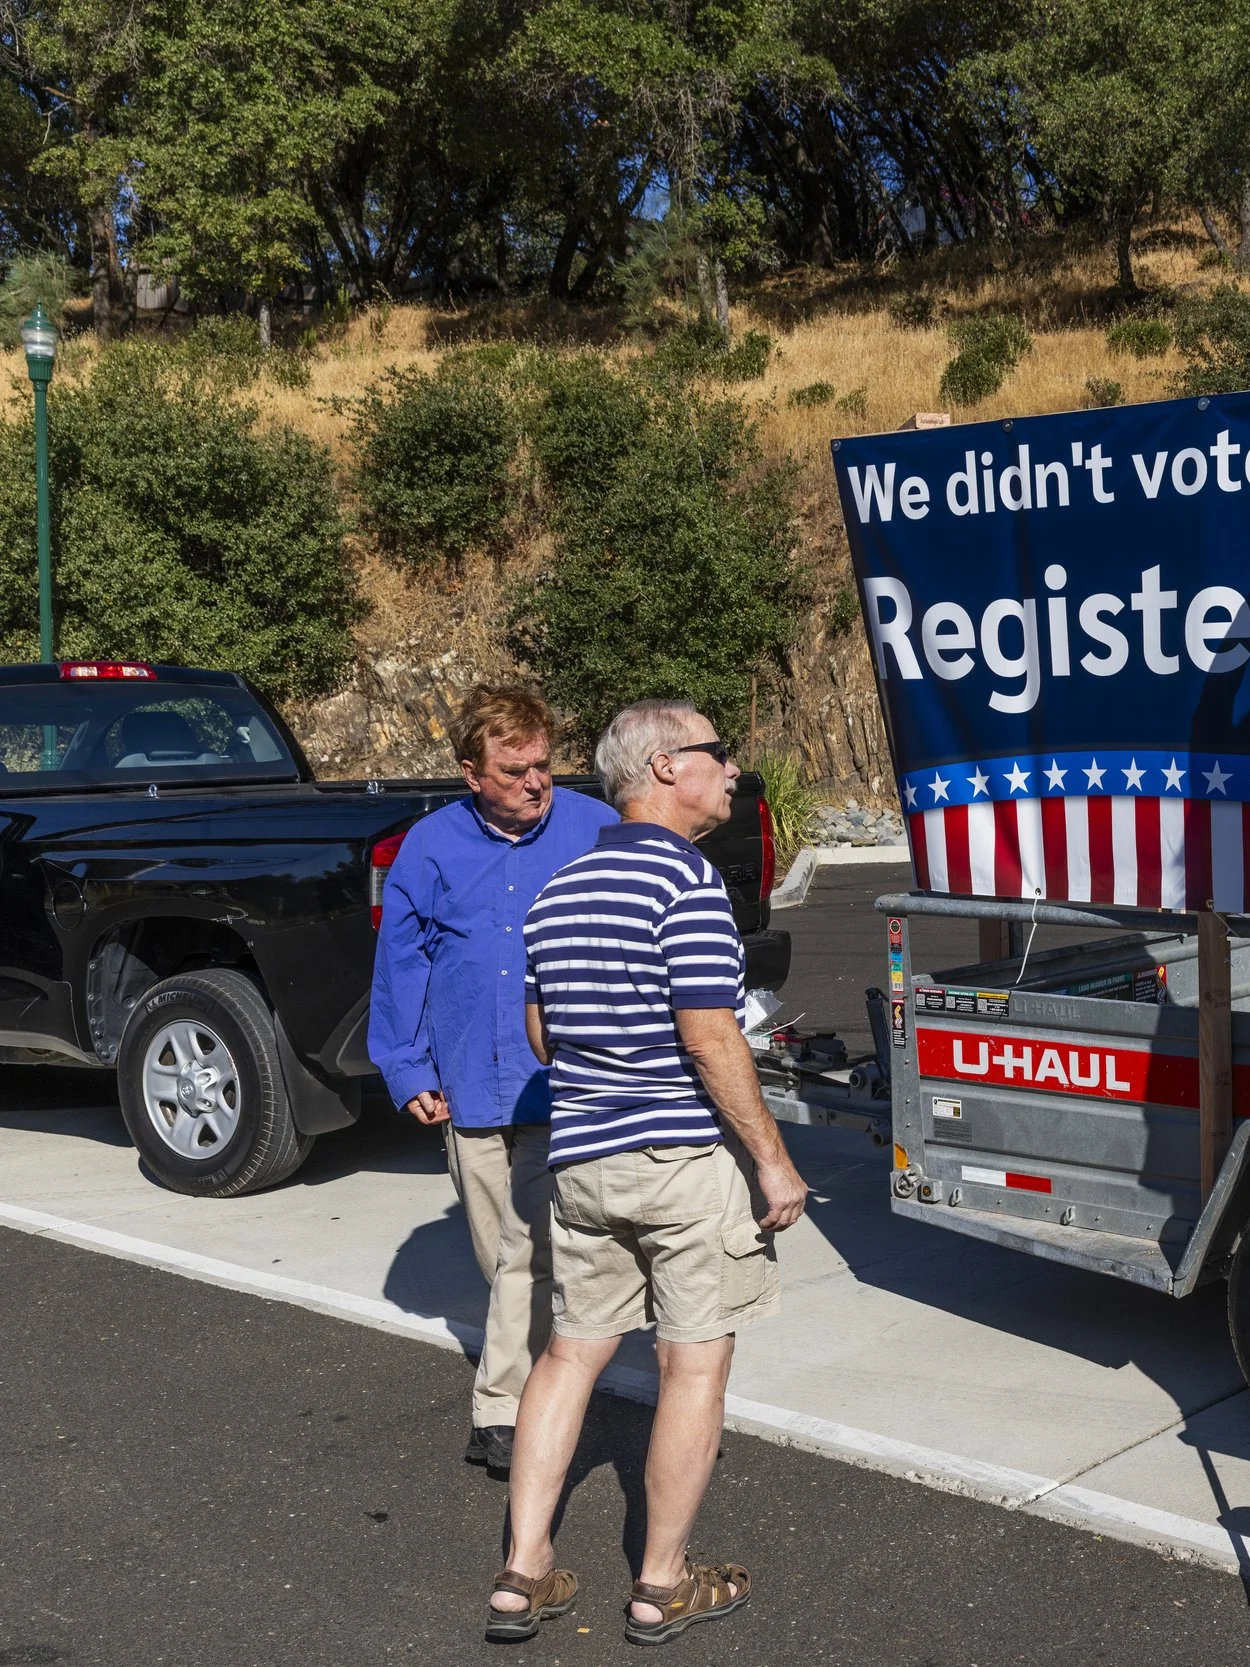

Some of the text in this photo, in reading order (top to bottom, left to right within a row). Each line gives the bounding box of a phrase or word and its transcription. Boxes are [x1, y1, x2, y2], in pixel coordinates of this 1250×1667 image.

[846, 462, 930, 524] We
[946, 441, 1115, 515] didn't
[952, 1039, 1131, 1092] U-HAUL
